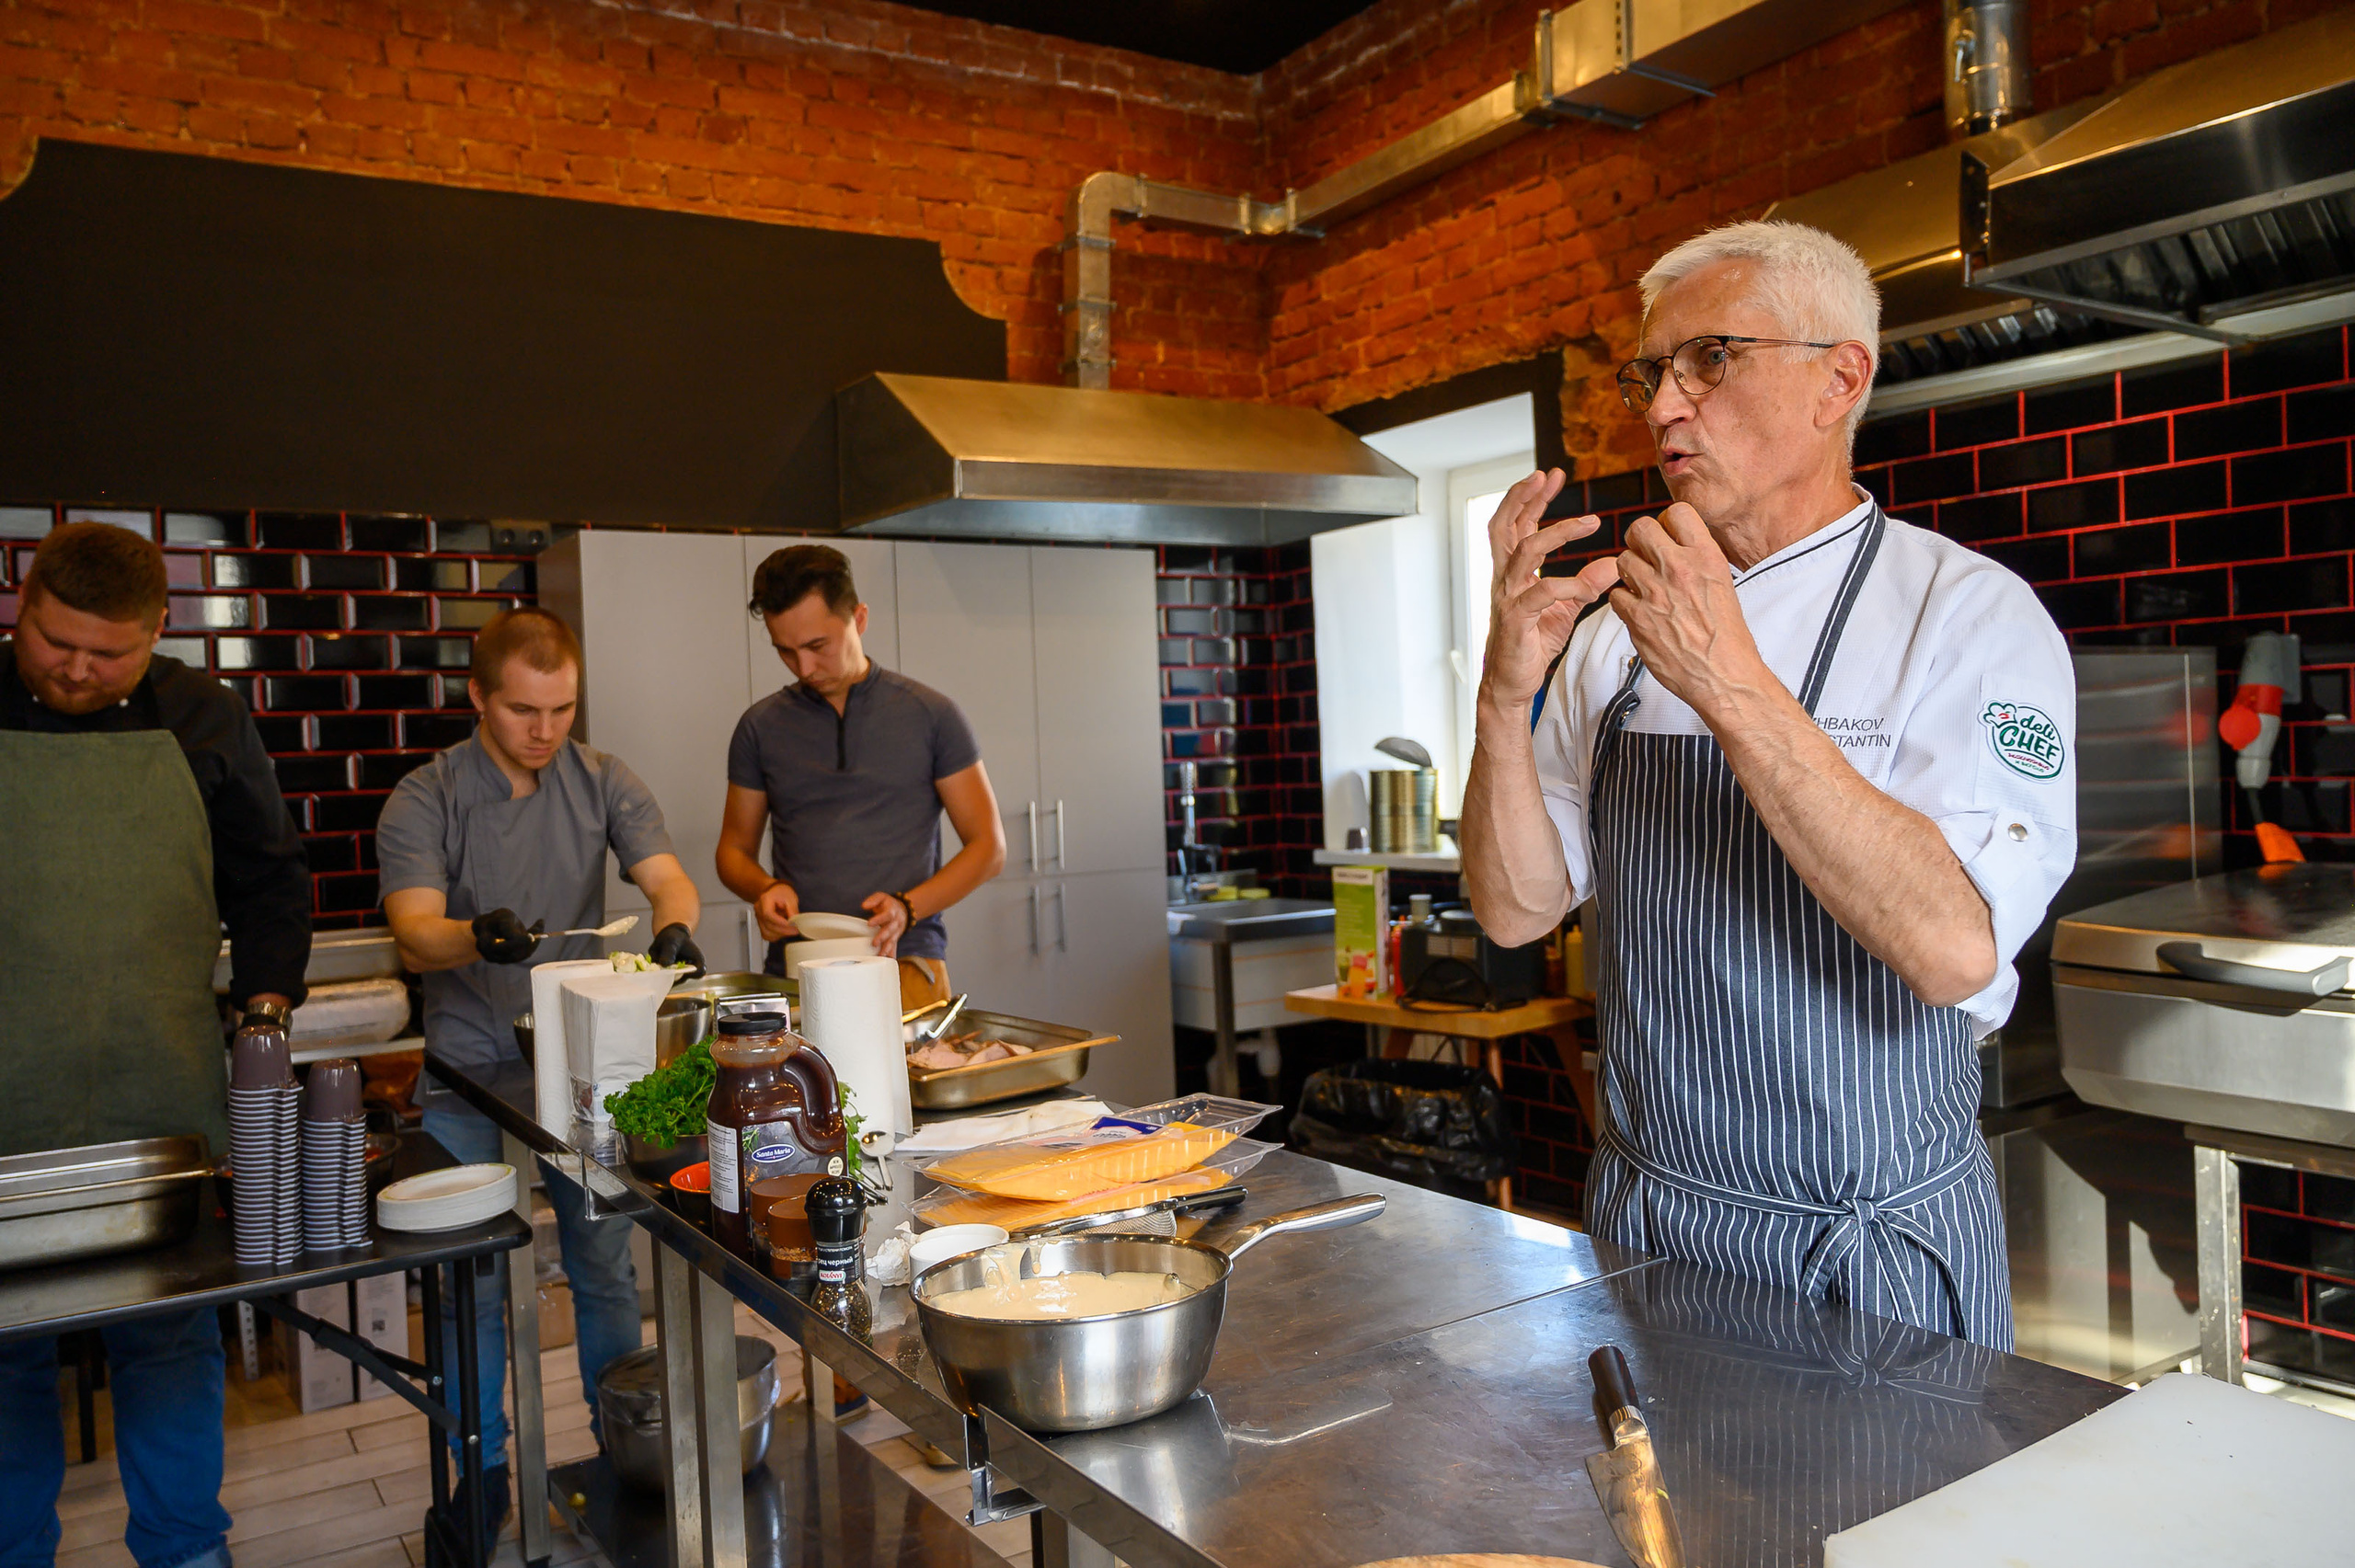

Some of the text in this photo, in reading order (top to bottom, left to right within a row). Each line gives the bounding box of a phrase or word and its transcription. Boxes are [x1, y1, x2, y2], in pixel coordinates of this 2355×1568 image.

[2020, 715, 2055, 740] deli
[1999, 726, 2060, 761] CHEF
[774, 1147, 791, 1155] Maria
